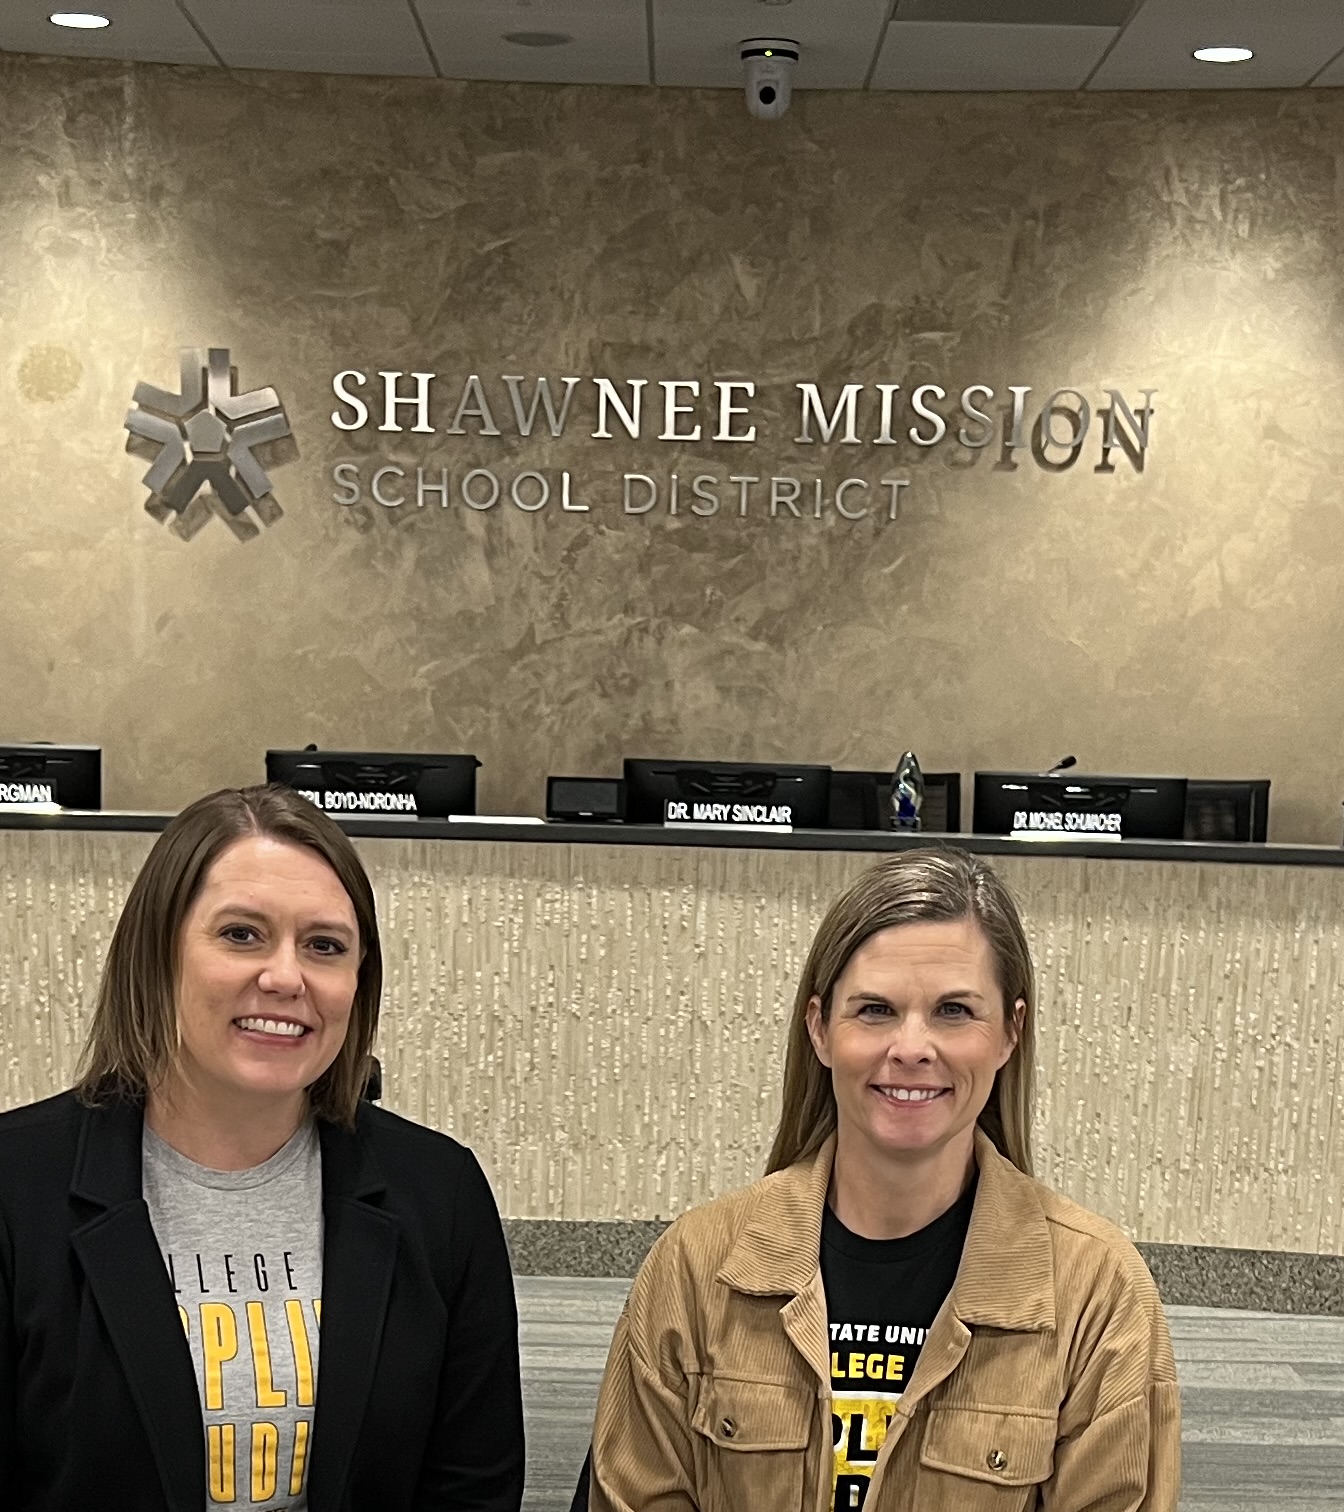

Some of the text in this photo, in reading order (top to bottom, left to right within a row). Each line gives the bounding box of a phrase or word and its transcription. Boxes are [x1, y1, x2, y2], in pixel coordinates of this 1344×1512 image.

[331, 369, 1155, 450] SHAWNEE MISSION
[331, 463, 912, 521] SCHOOL DISTRICT
[667, 802, 793, 824] DR. MARY SINCLAIR
